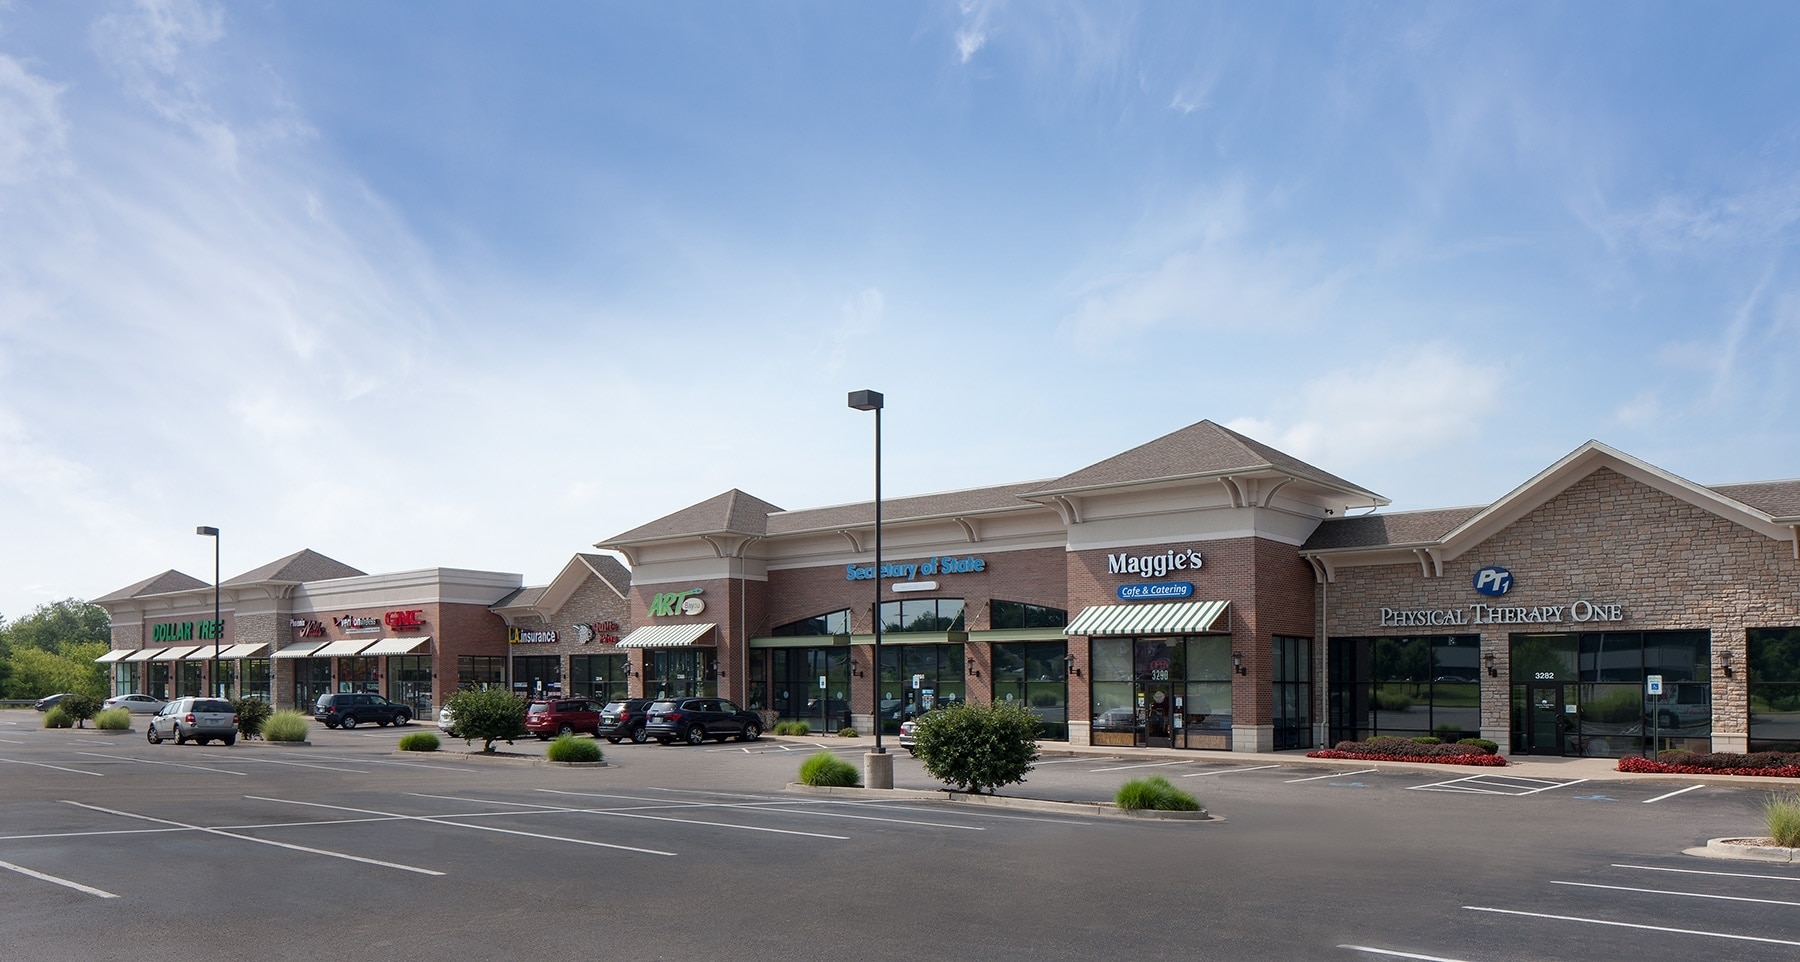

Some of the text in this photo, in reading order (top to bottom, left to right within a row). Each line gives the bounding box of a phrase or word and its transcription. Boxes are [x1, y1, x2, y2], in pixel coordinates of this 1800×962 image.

[846, 556, 985, 580] Secretary of State
[1108, 549, 1202, 577] Maggie's
[1122, 585, 1187, 597] Cafe & Catering
[1476, 569, 1510, 594] PT1
[647, 589, 699, 617] ART
[684, 601, 701, 611] Bayou
[385, 610, 424, 626] GNC
[1379, 600, 1623, 627] PHYSICAL THERAPY ONE
[152, 619, 224, 642] DOLLAR TREE
[1151, 660, 1169, 669] OPEN
[1152, 669, 1169, 680] 3290
[1535, 672, 1555, 680] 3282
